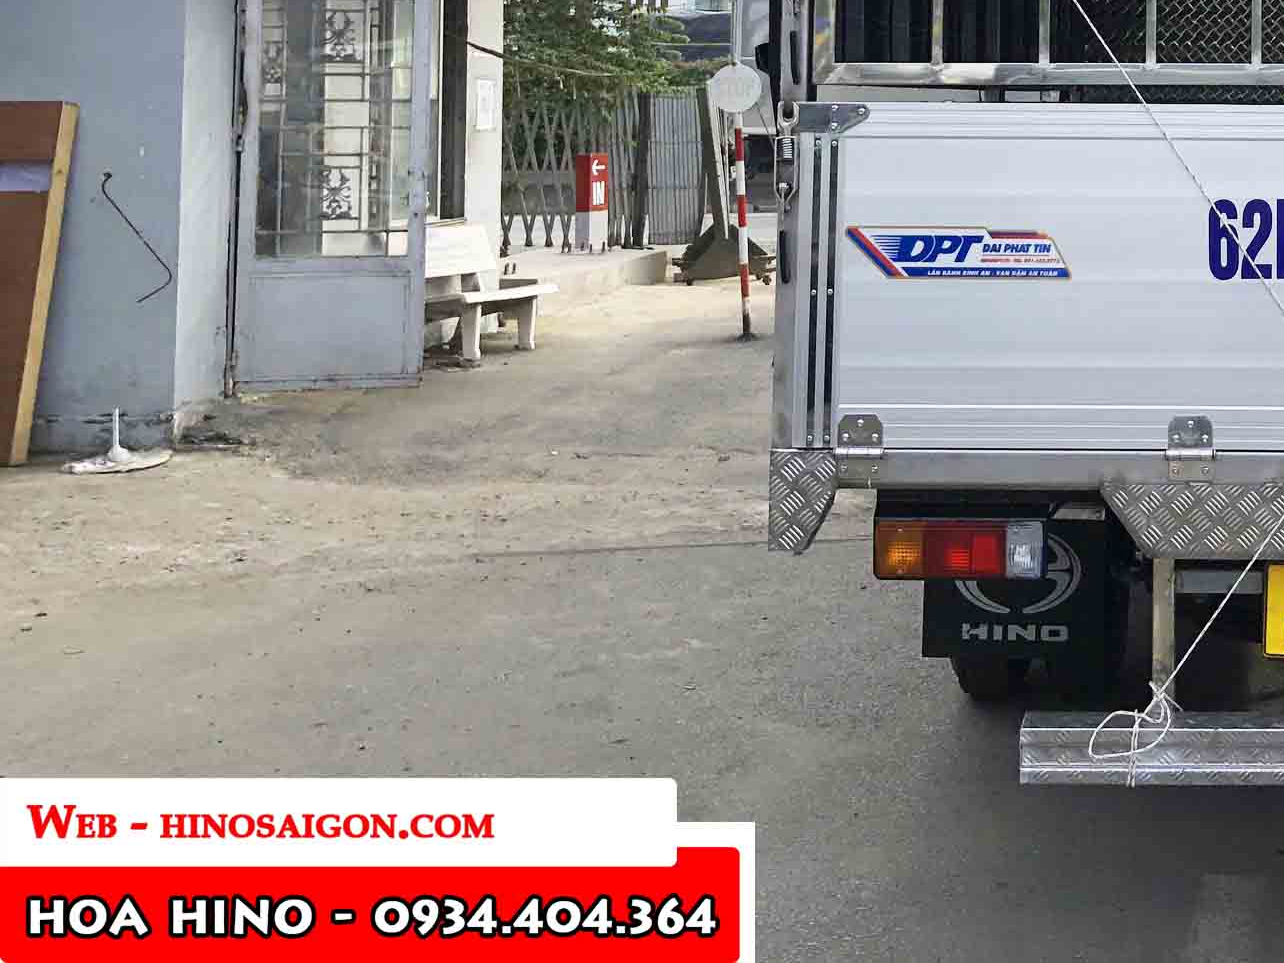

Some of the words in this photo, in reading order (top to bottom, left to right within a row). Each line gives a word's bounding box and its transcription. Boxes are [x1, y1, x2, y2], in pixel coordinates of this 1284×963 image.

[592, 180, 605, 206] IN
[897, 235, 985, 263] DPT
[961, 623, 1069, 642] HINO
